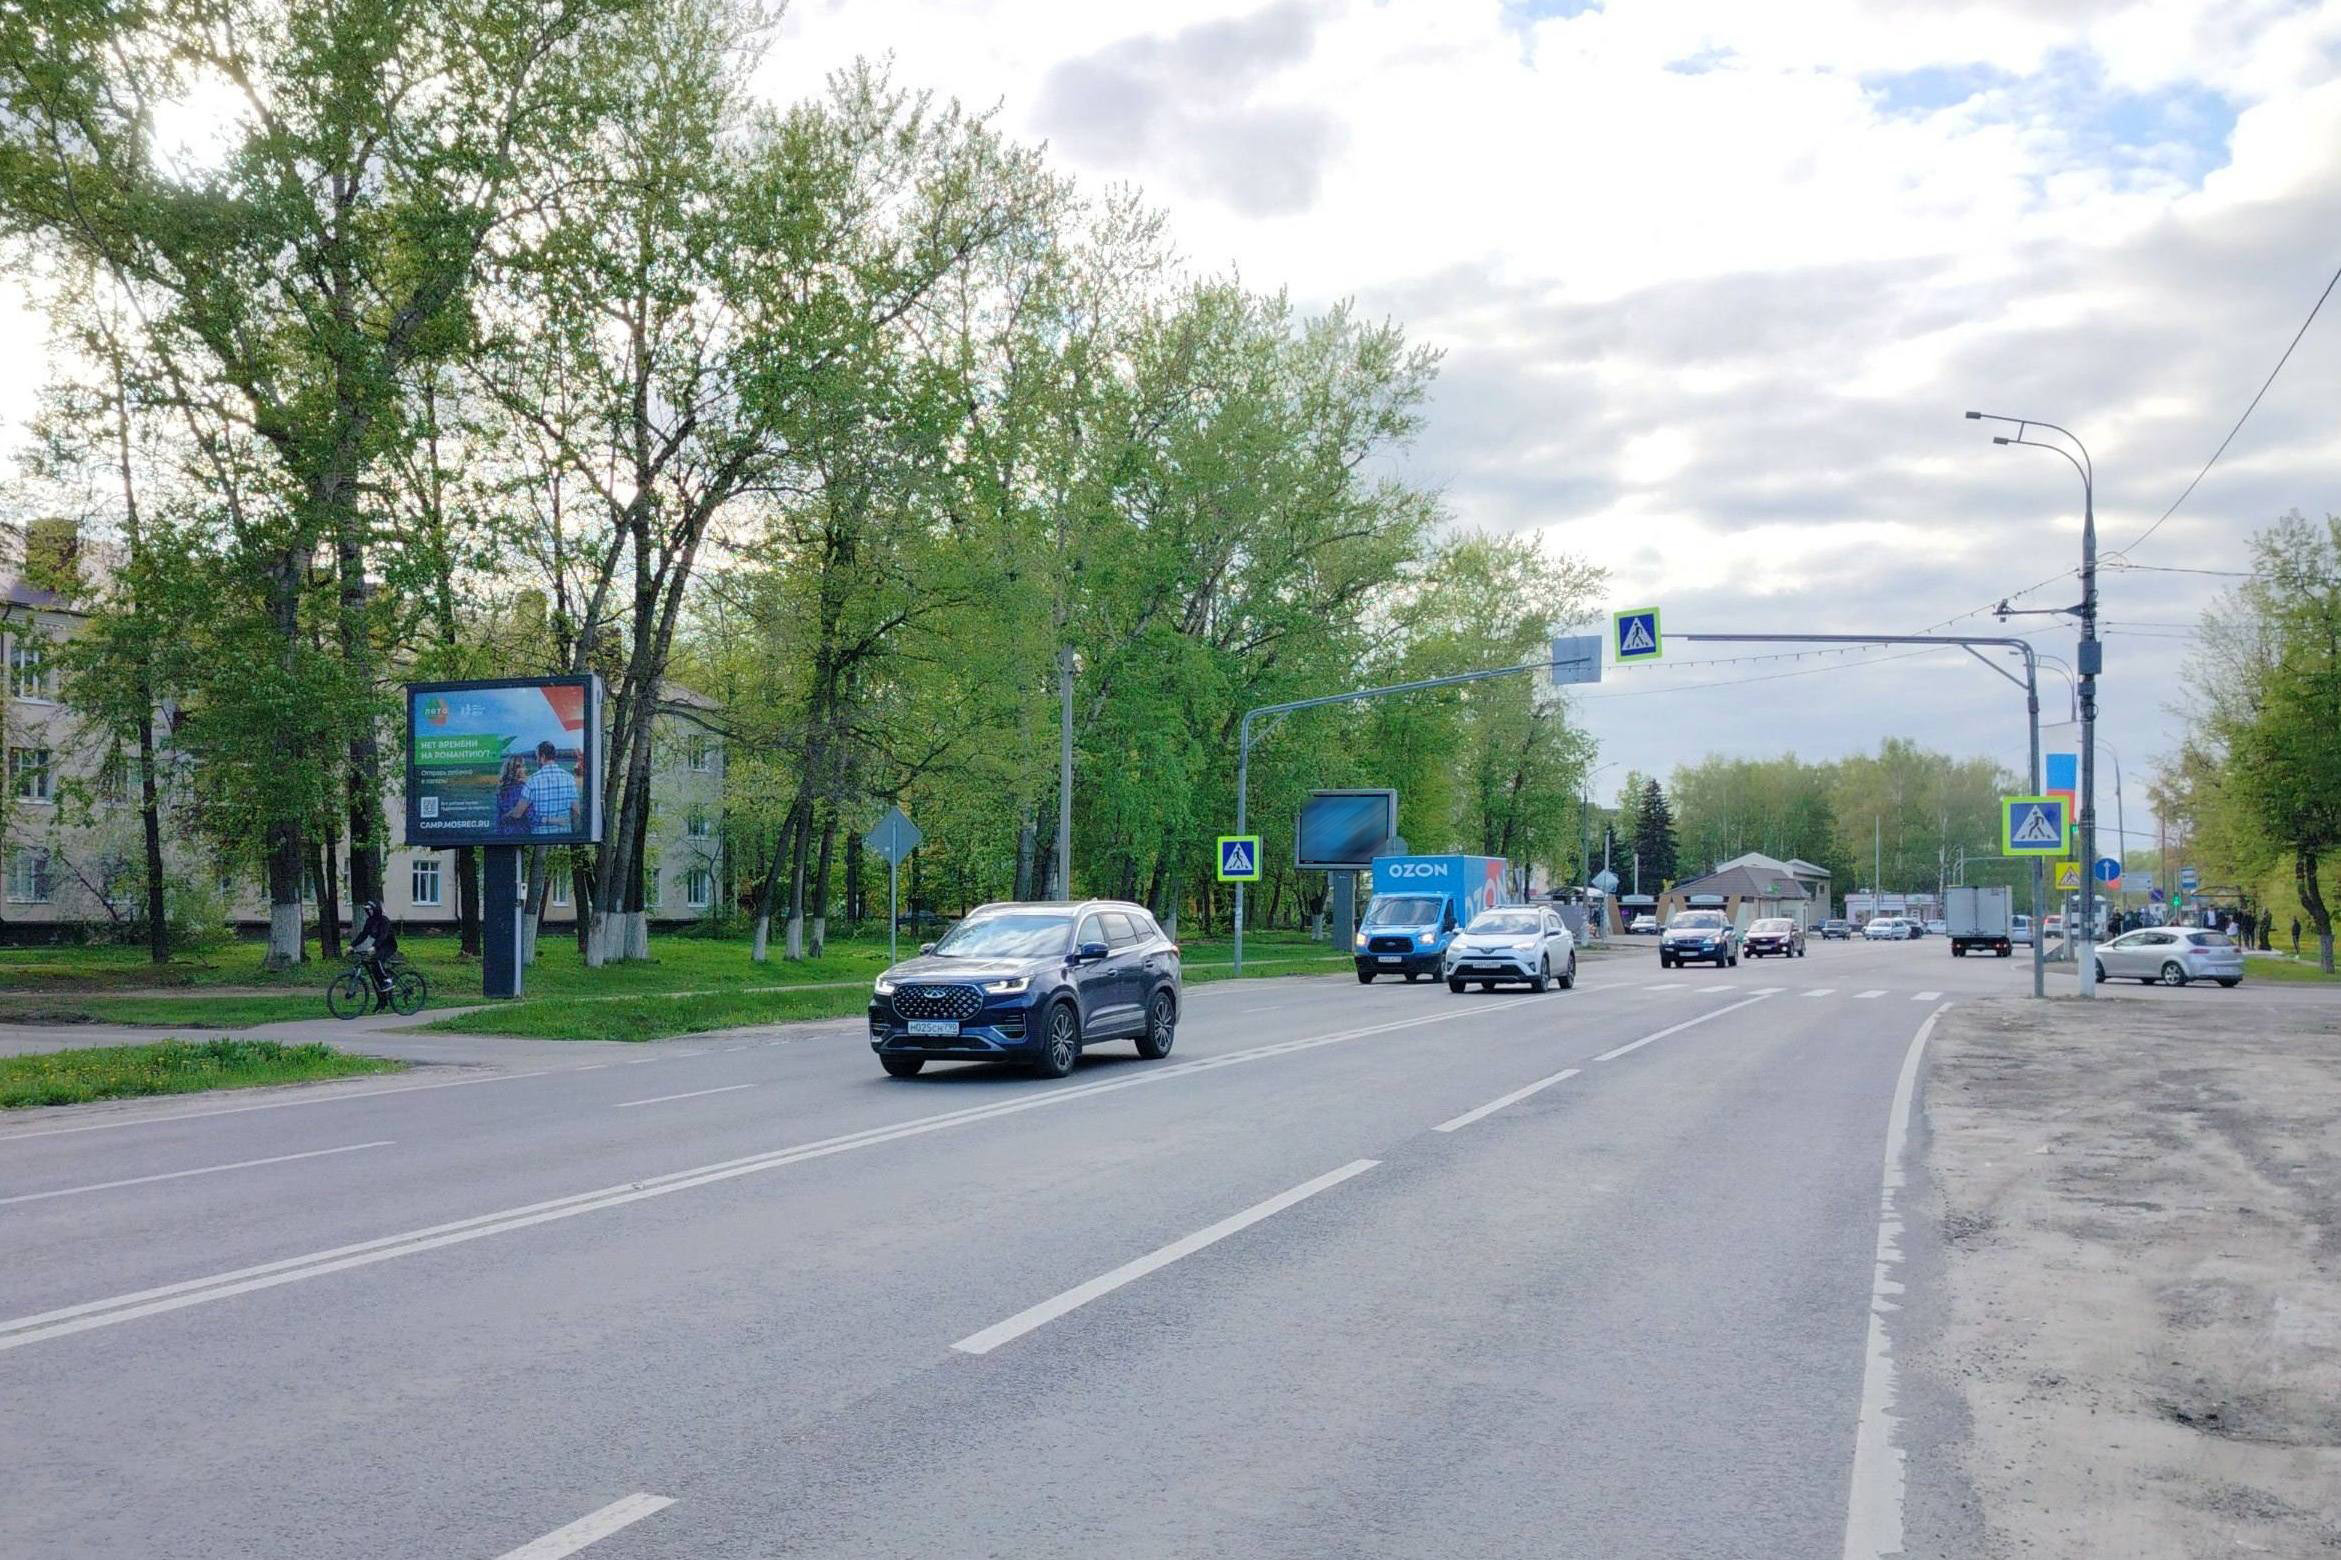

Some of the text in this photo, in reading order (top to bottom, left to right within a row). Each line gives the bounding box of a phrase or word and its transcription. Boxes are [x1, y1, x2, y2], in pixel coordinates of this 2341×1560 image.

[421, 739, 478, 749] НЕТ ВРЕМЕНИ
[420, 820, 490, 830] CAMP.MOSREG.RU
[1389, 863, 1448, 878] OZON
